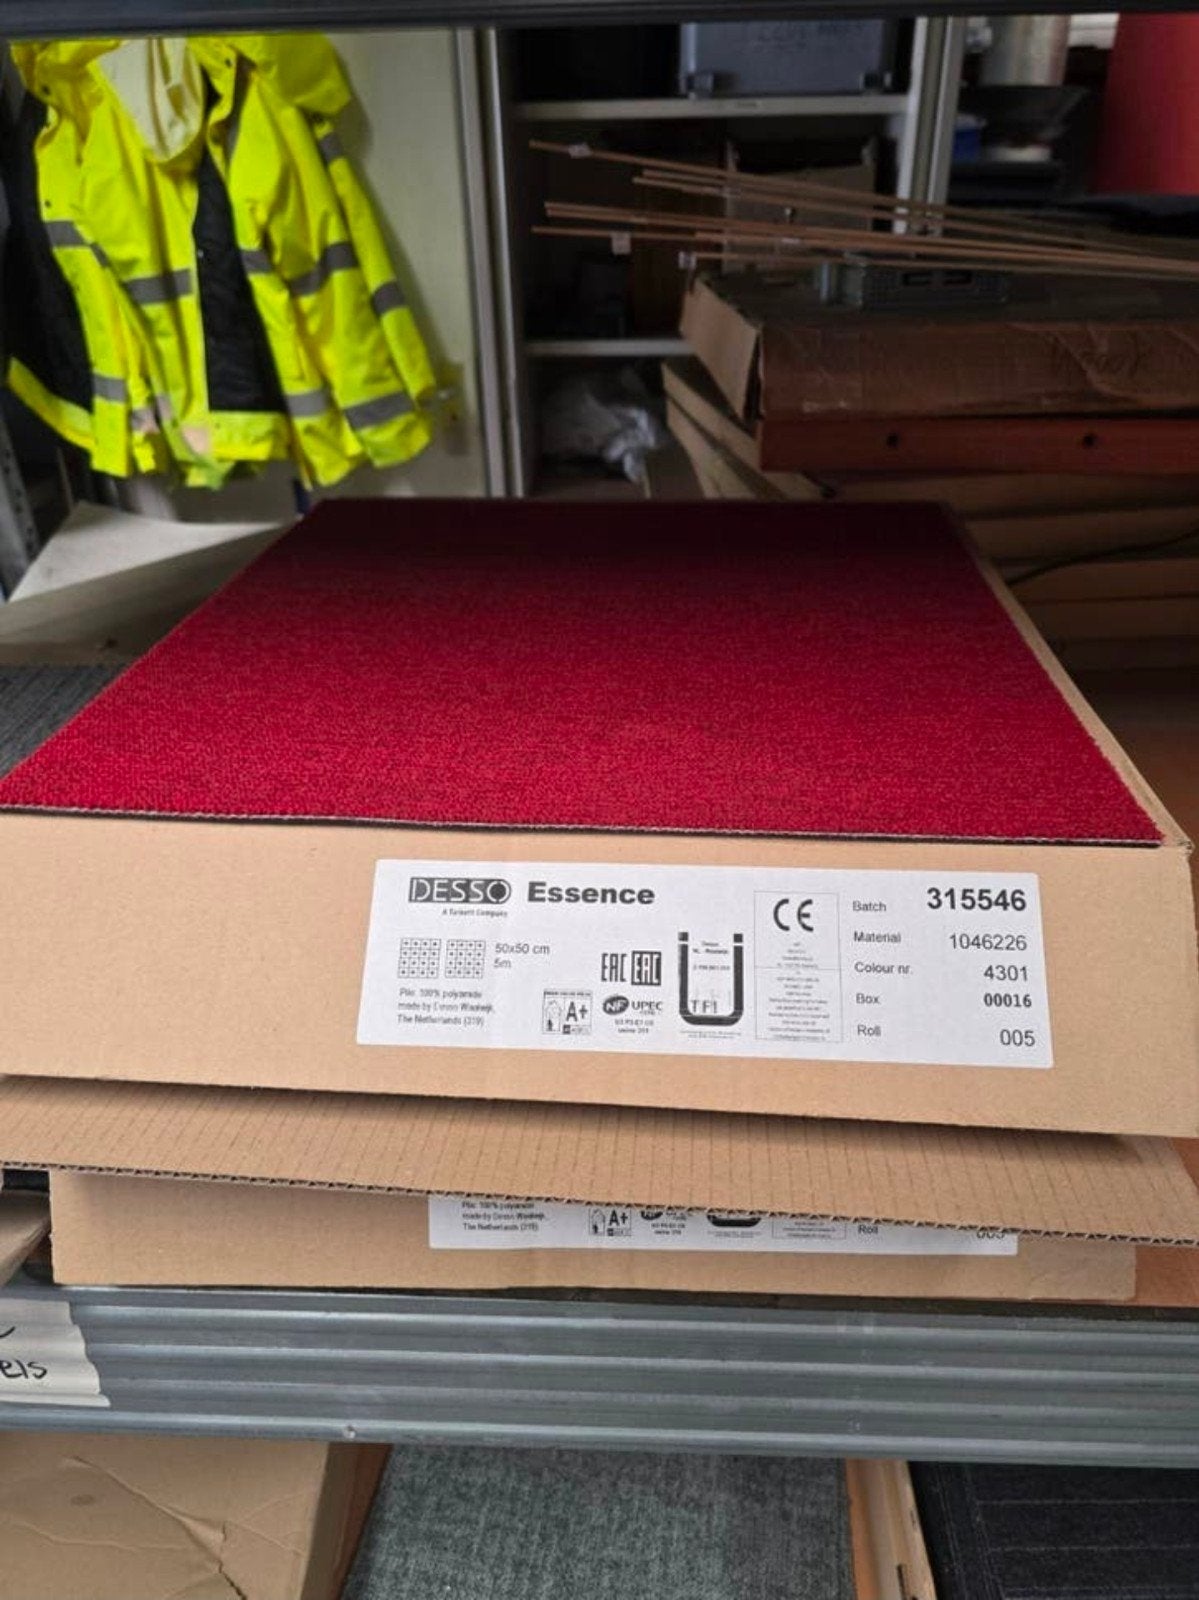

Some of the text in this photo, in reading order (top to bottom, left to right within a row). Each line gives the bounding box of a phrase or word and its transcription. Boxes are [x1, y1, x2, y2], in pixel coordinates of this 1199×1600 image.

[408, 877, 511, 904] DESSO
[527, 881, 655, 905] Essence
[852, 887, 1027, 913] Batch 315546
[773, 898, 814, 932] CE
[495, 943, 550, 956] 50x50 cm
[853, 931, 1028, 952] Material 1046226
[493, 958, 512, 970] 5m
[854, 962, 894, 975] Colour
[983, 964, 1029, 982] 4301
[566, 1000, 588, 1022] A+
[856, 993, 1032, 1009] Box 00016
[857, 1024, 1036, 1047] Roll 005
[609, 1209, 628, 1226] A+
[857, 1223, 878, 1235] Roll
